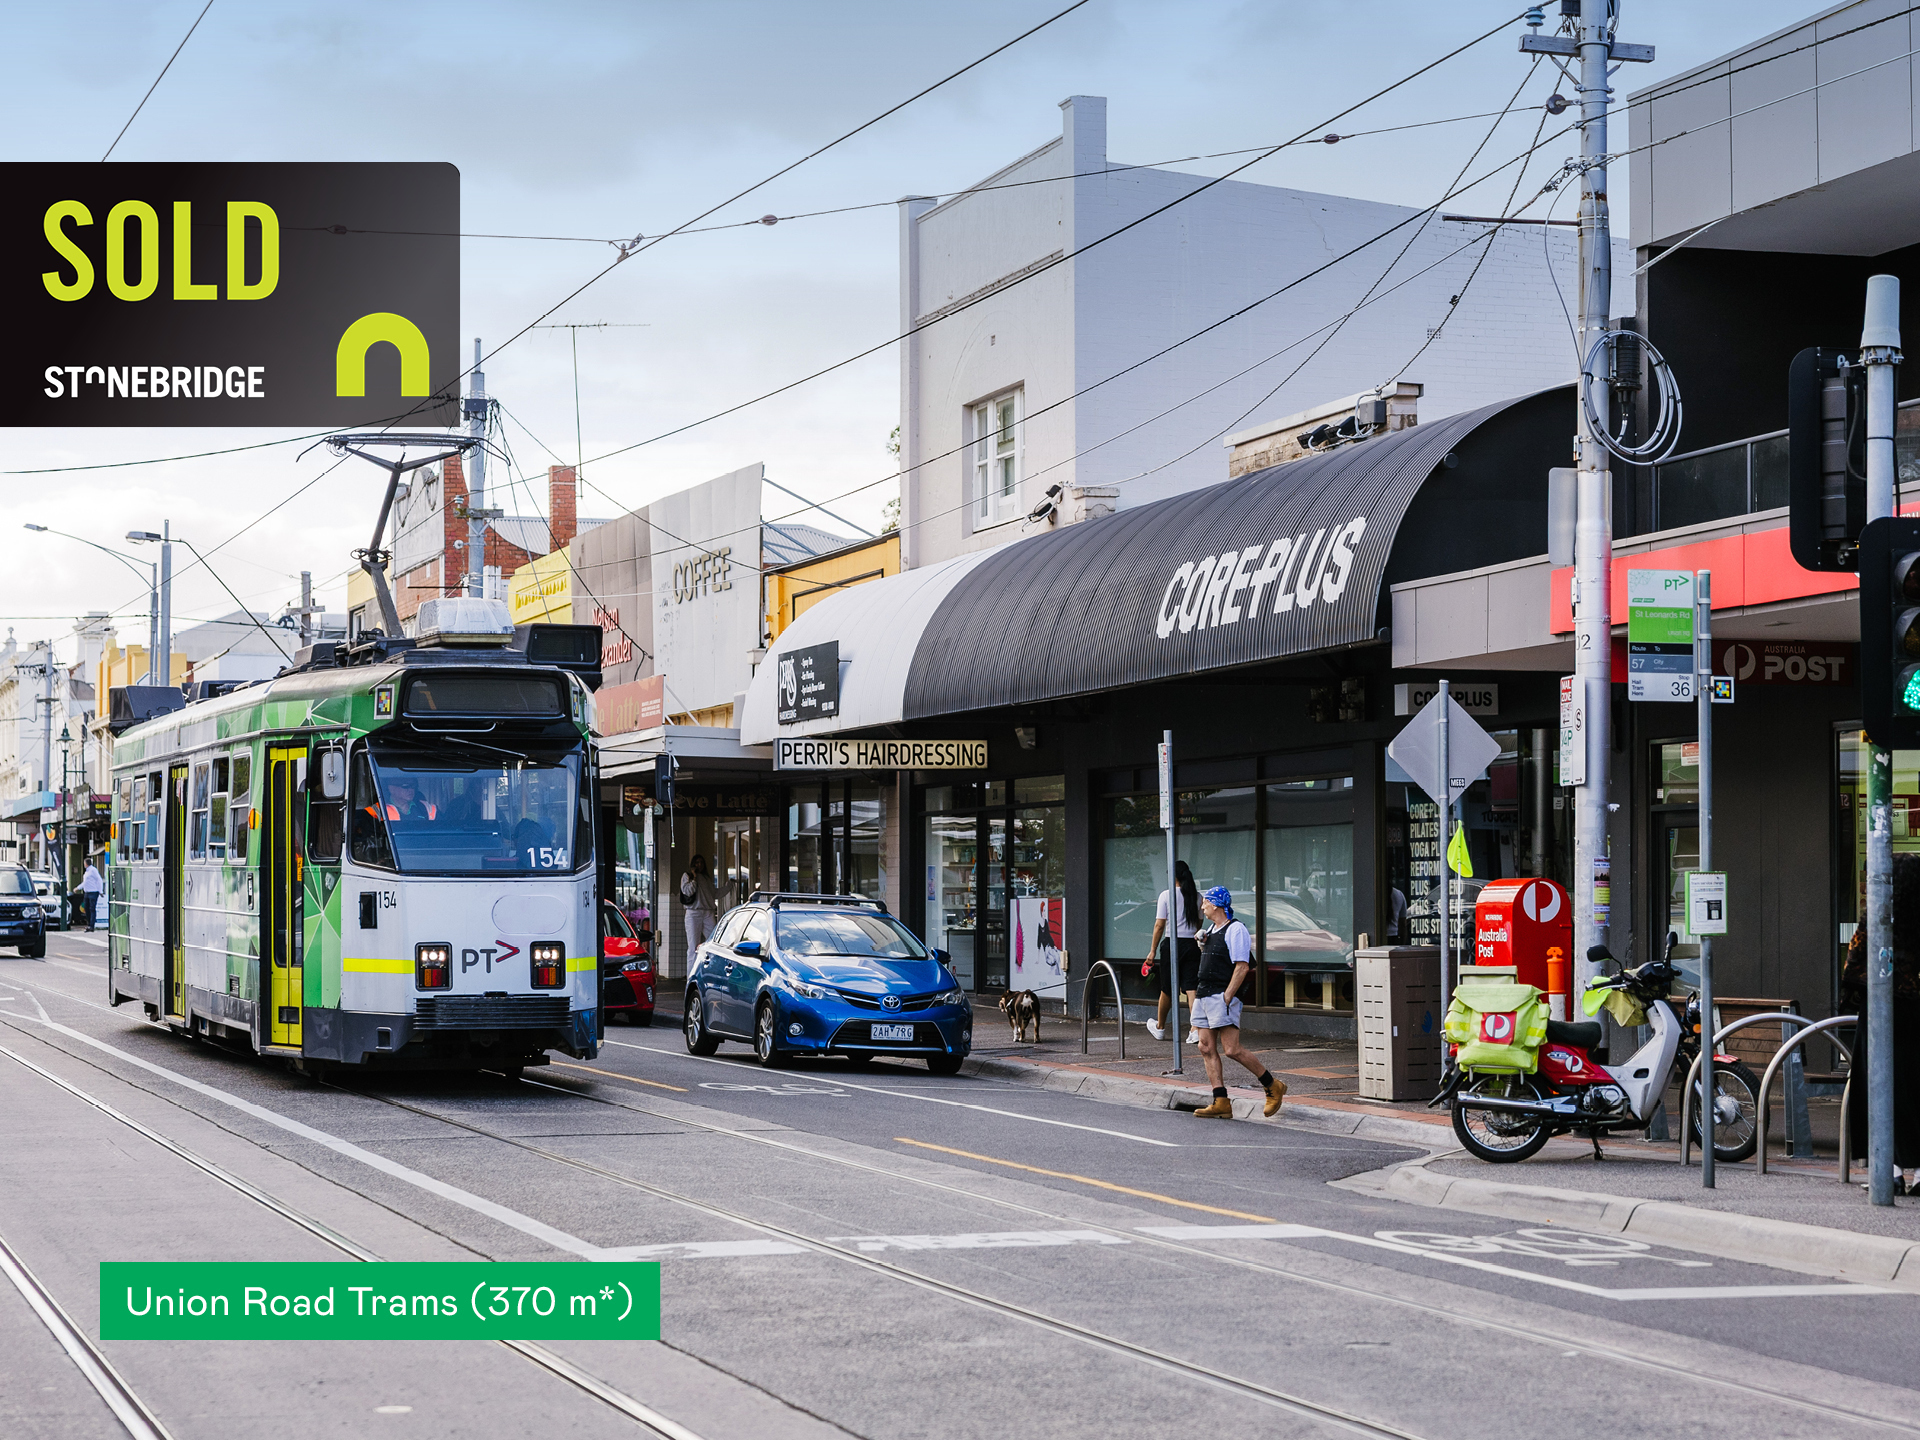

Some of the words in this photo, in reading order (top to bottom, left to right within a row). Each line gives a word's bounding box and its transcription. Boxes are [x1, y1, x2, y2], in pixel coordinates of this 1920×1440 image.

[673, 547, 732, 604] COFFEE
[1635, 610, 1643, 618] St
[1645, 611, 1678, 619] Leonards
[1680, 611, 1690, 619] Rd
[601, 631, 632, 669] exander
[1765, 645, 1806, 654] AUSTRALIA
[1631, 659, 1645, 669] 57
[1654, 659, 1664, 667] City
[1765, 655, 1845, 681] POST
[1671, 681, 1691, 697] 36
[782, 741, 850, 765] PERRI'S
[857, 742, 985, 766] HAIRDRESSING
[716, 793, 768, 809] Latte
[1410, 823, 1439, 838] PILATES
[527, 847, 568, 868] 154
[1410, 843, 1430, 857] YOGA
[1410, 880, 1429, 896] PLUS
[377, 891, 397, 909] 154
[1410, 899, 1429, 915] PLUS
[1410, 918, 1430, 934] PLUS
[1478, 928, 1508, 943] Australia
[1478, 944, 1494, 958] Post
[462, 949, 497, 973] PT
